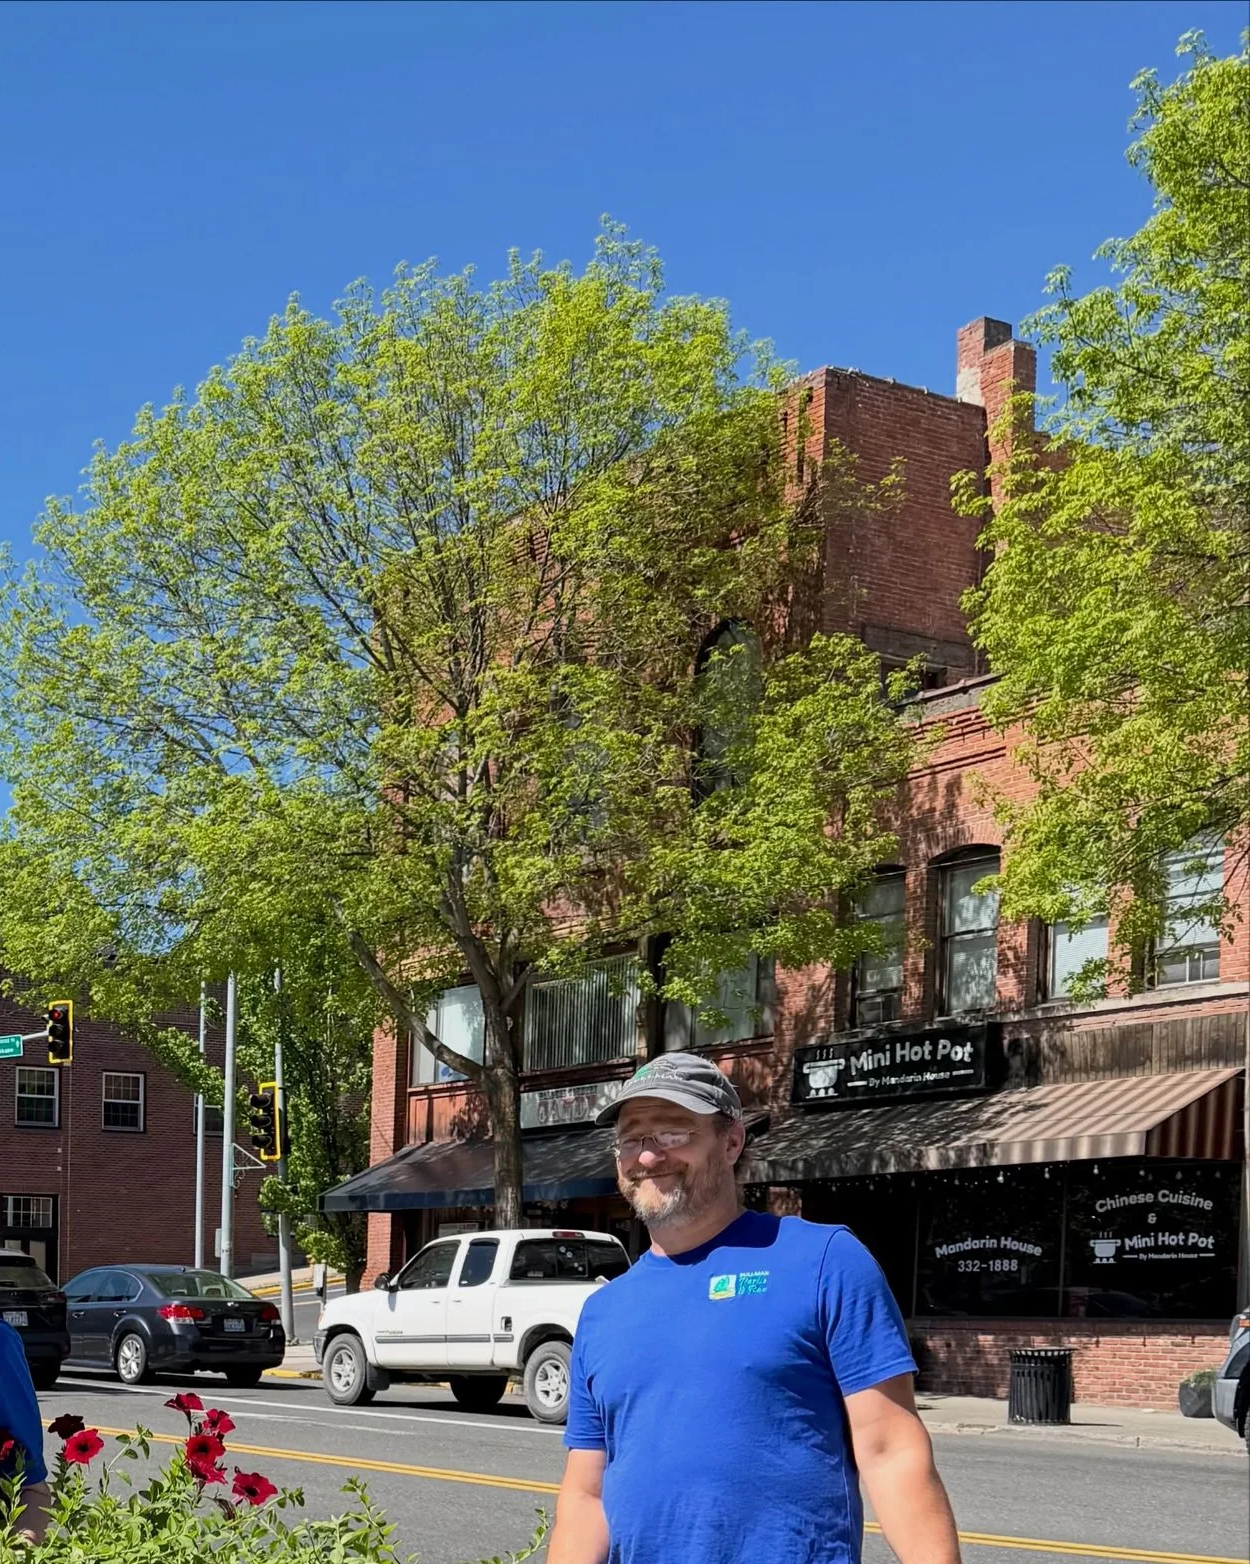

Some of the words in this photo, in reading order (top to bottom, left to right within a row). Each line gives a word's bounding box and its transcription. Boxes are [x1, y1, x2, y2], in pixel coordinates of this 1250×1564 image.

[850, 1044, 891, 1076] Mini
[896, 1040, 933, 1064] Hot
[937, 1039, 974, 1063] Pot
[868, 1077, 880, 1089] By
[881, 1072, 922, 1086] Mandarin
[923, 1072, 950, 1082] House
[1095, 1194, 1155, 1213] Chinese
[1158, 1190, 1214, 1210] Cuisine
[1147, 1213, 1157, 1224] &
[935, 1235, 998, 1258] Mandarin
[1000, 1236, 1043, 1256] House
[1124, 1232, 1155, 1251] Mini
[1157, 1231, 1185, 1245] Hot
[1188, 1232, 1215, 1249] Pot
[957, 1259, 1018, 1272] 332-1888
